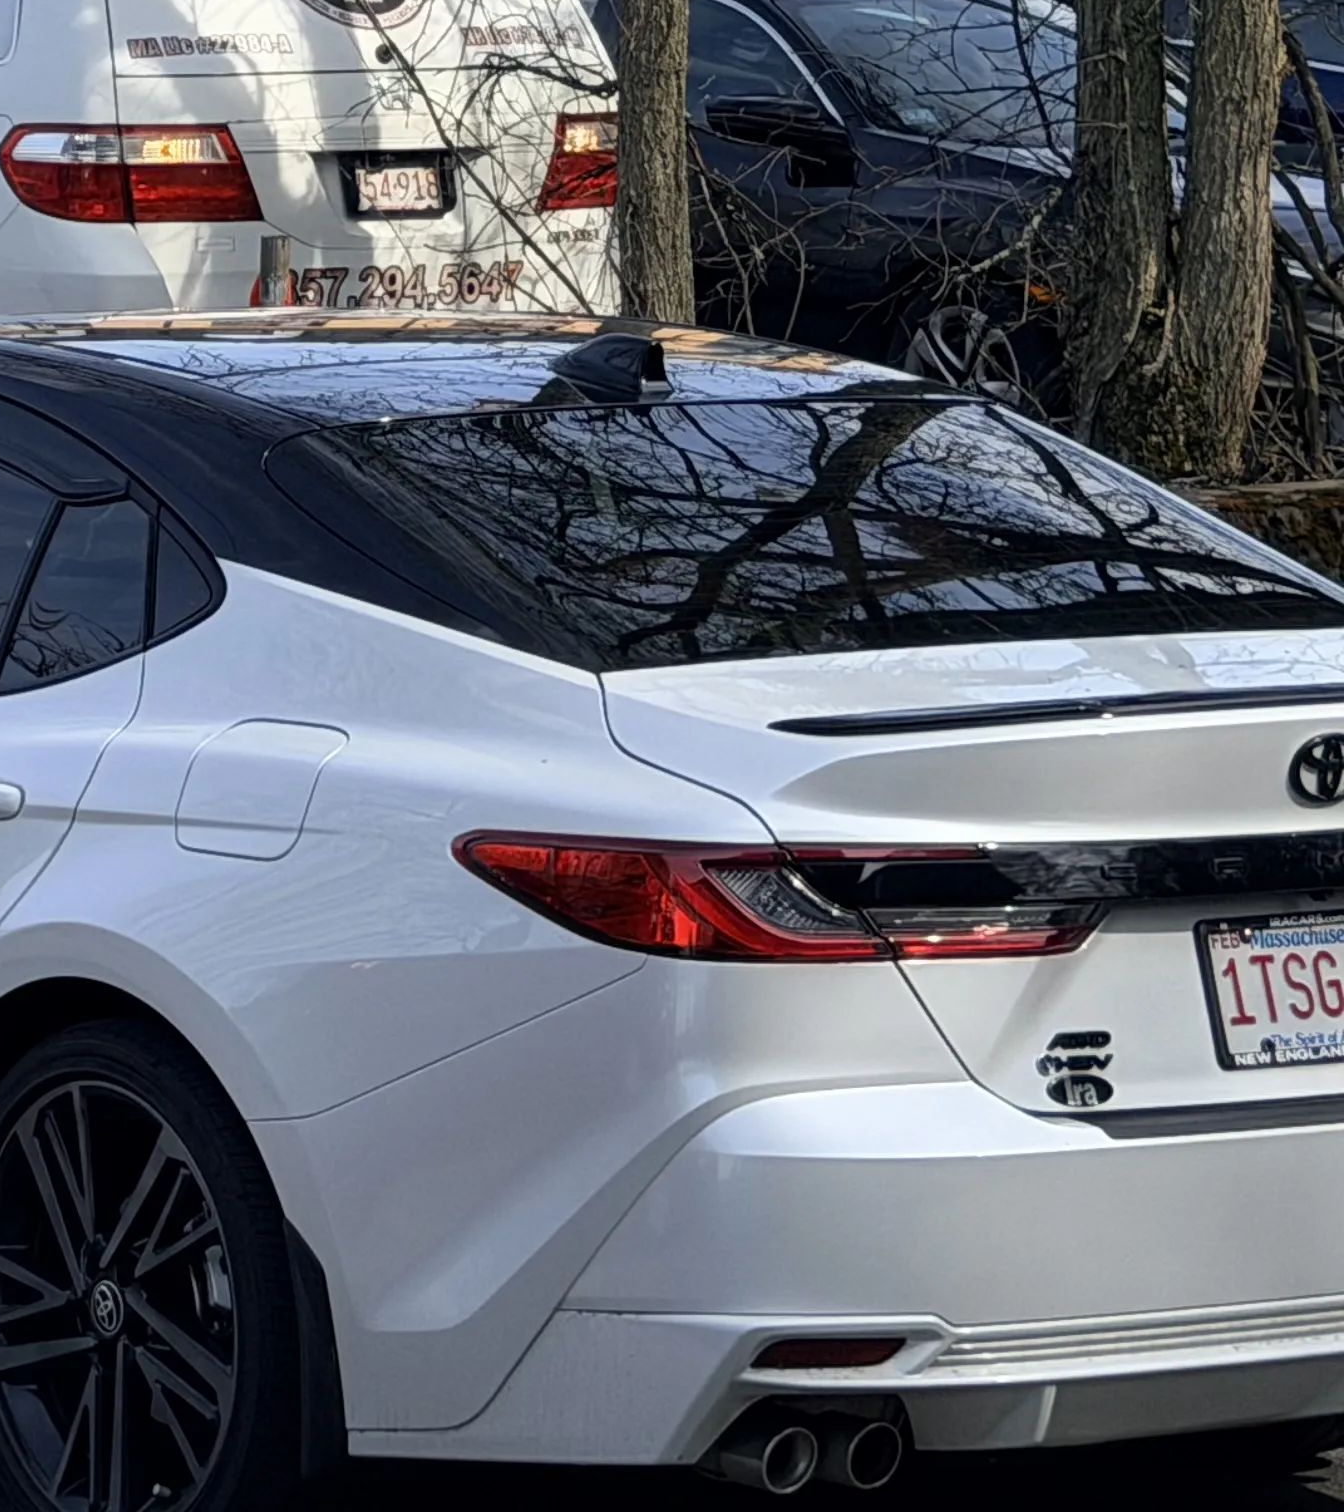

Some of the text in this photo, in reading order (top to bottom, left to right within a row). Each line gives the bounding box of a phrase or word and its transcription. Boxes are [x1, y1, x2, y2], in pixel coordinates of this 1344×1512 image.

[126, 37, 163, 59] MA
[161, 35, 194, 57] Lic
[1211, 933, 1241, 949] FEB
[1222, 949, 1344, 1027] 1TSG
[1235, 1051, 1271, 1066] NEW
[1063, 1076, 1100, 1105] Ira
